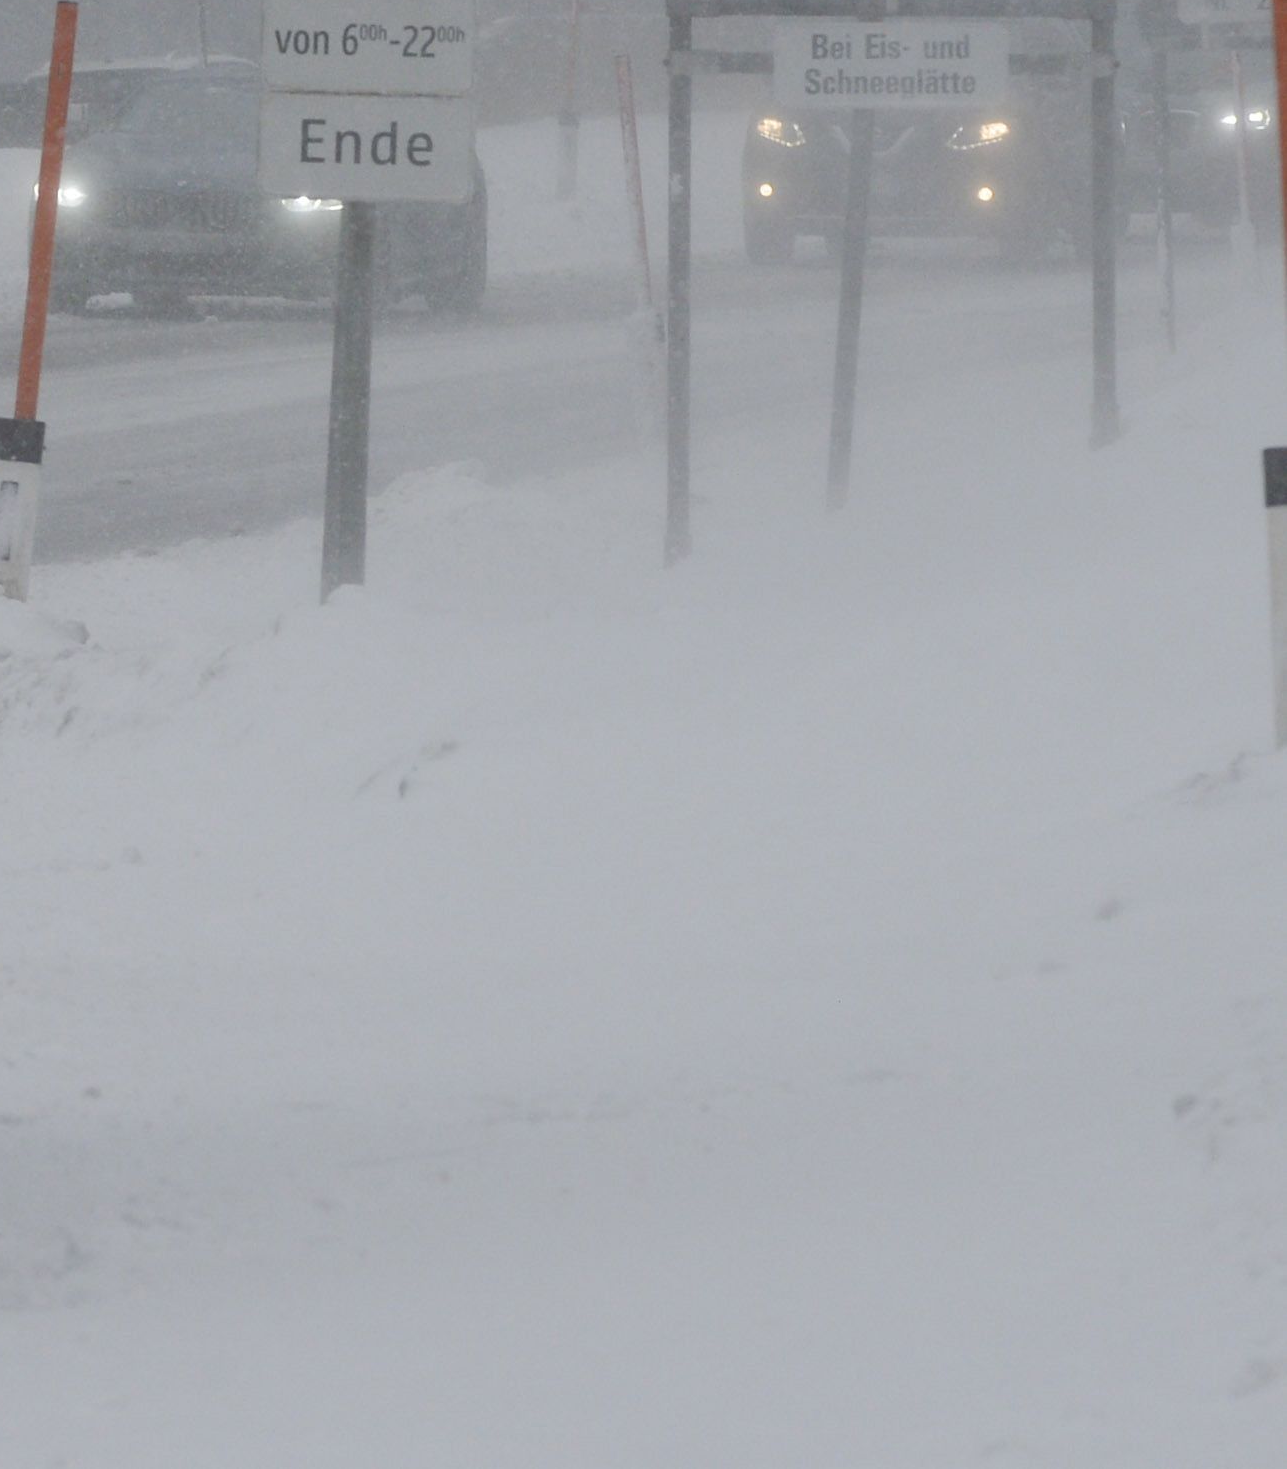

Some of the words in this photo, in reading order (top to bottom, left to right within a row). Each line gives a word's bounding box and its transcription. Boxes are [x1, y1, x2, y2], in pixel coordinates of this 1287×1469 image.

[274, 29, 330, 55] von
[810, 32, 852, 59] Bei
[864, 32, 911, 59] Eis-
[922, 33, 971, 59] und
[803, 67, 977, 98] Schneeglätte
[299, 118, 434, 167] Ende
